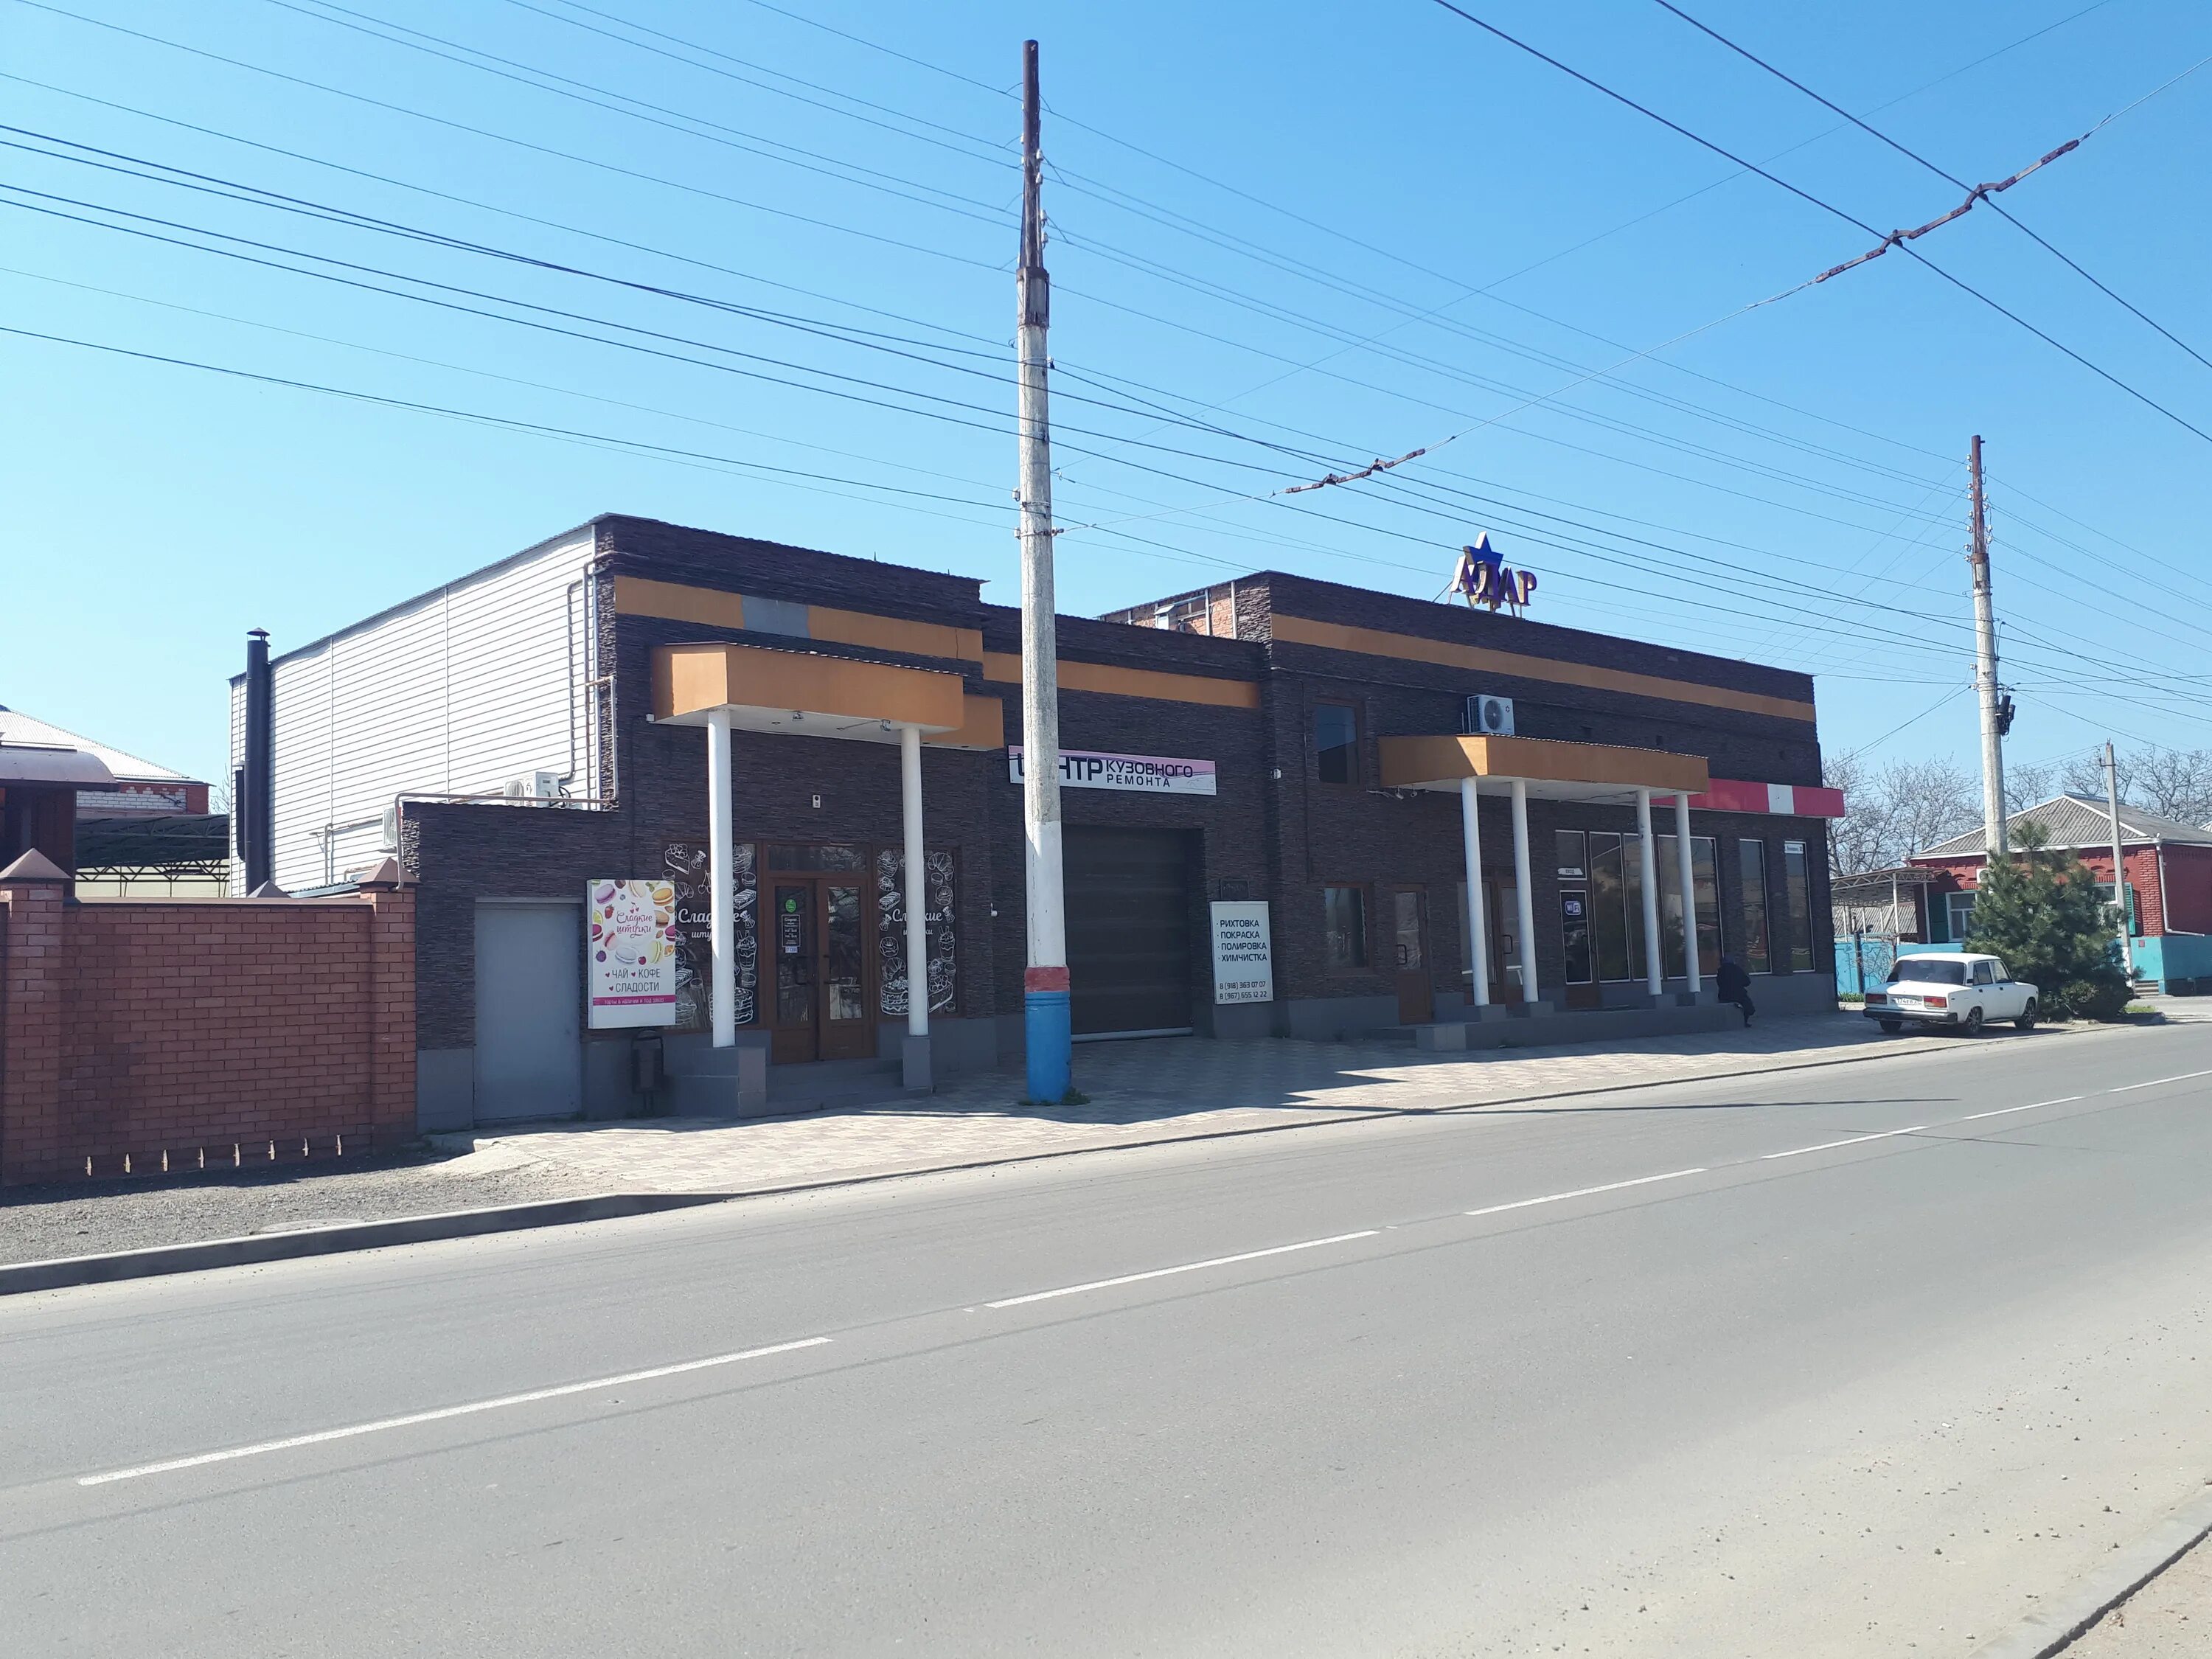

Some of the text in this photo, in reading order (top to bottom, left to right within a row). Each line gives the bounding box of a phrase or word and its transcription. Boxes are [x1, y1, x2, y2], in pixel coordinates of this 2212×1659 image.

[1018, 753, 1193, 781] НТР КУЗОВНОГО
[1107, 773, 1171, 787] РЕМОНТА
[616, 911, 653, 926] Сладкие
[678, 908, 741, 929] Сладе
[1220, 919, 1259, 928] РИХТОВКА
[616, 925, 651, 939] штучки
[1221, 942, 1267, 950] ПОЛИРОВКА
[1222, 953, 1267, 961] ХИМЧИСТКА
[612, 968, 661, 978] ЧАЙ КОФЕ
[616, 982, 659, 992] СЛАДОСТИ
[1225, 982, 1238, 990] (918)
